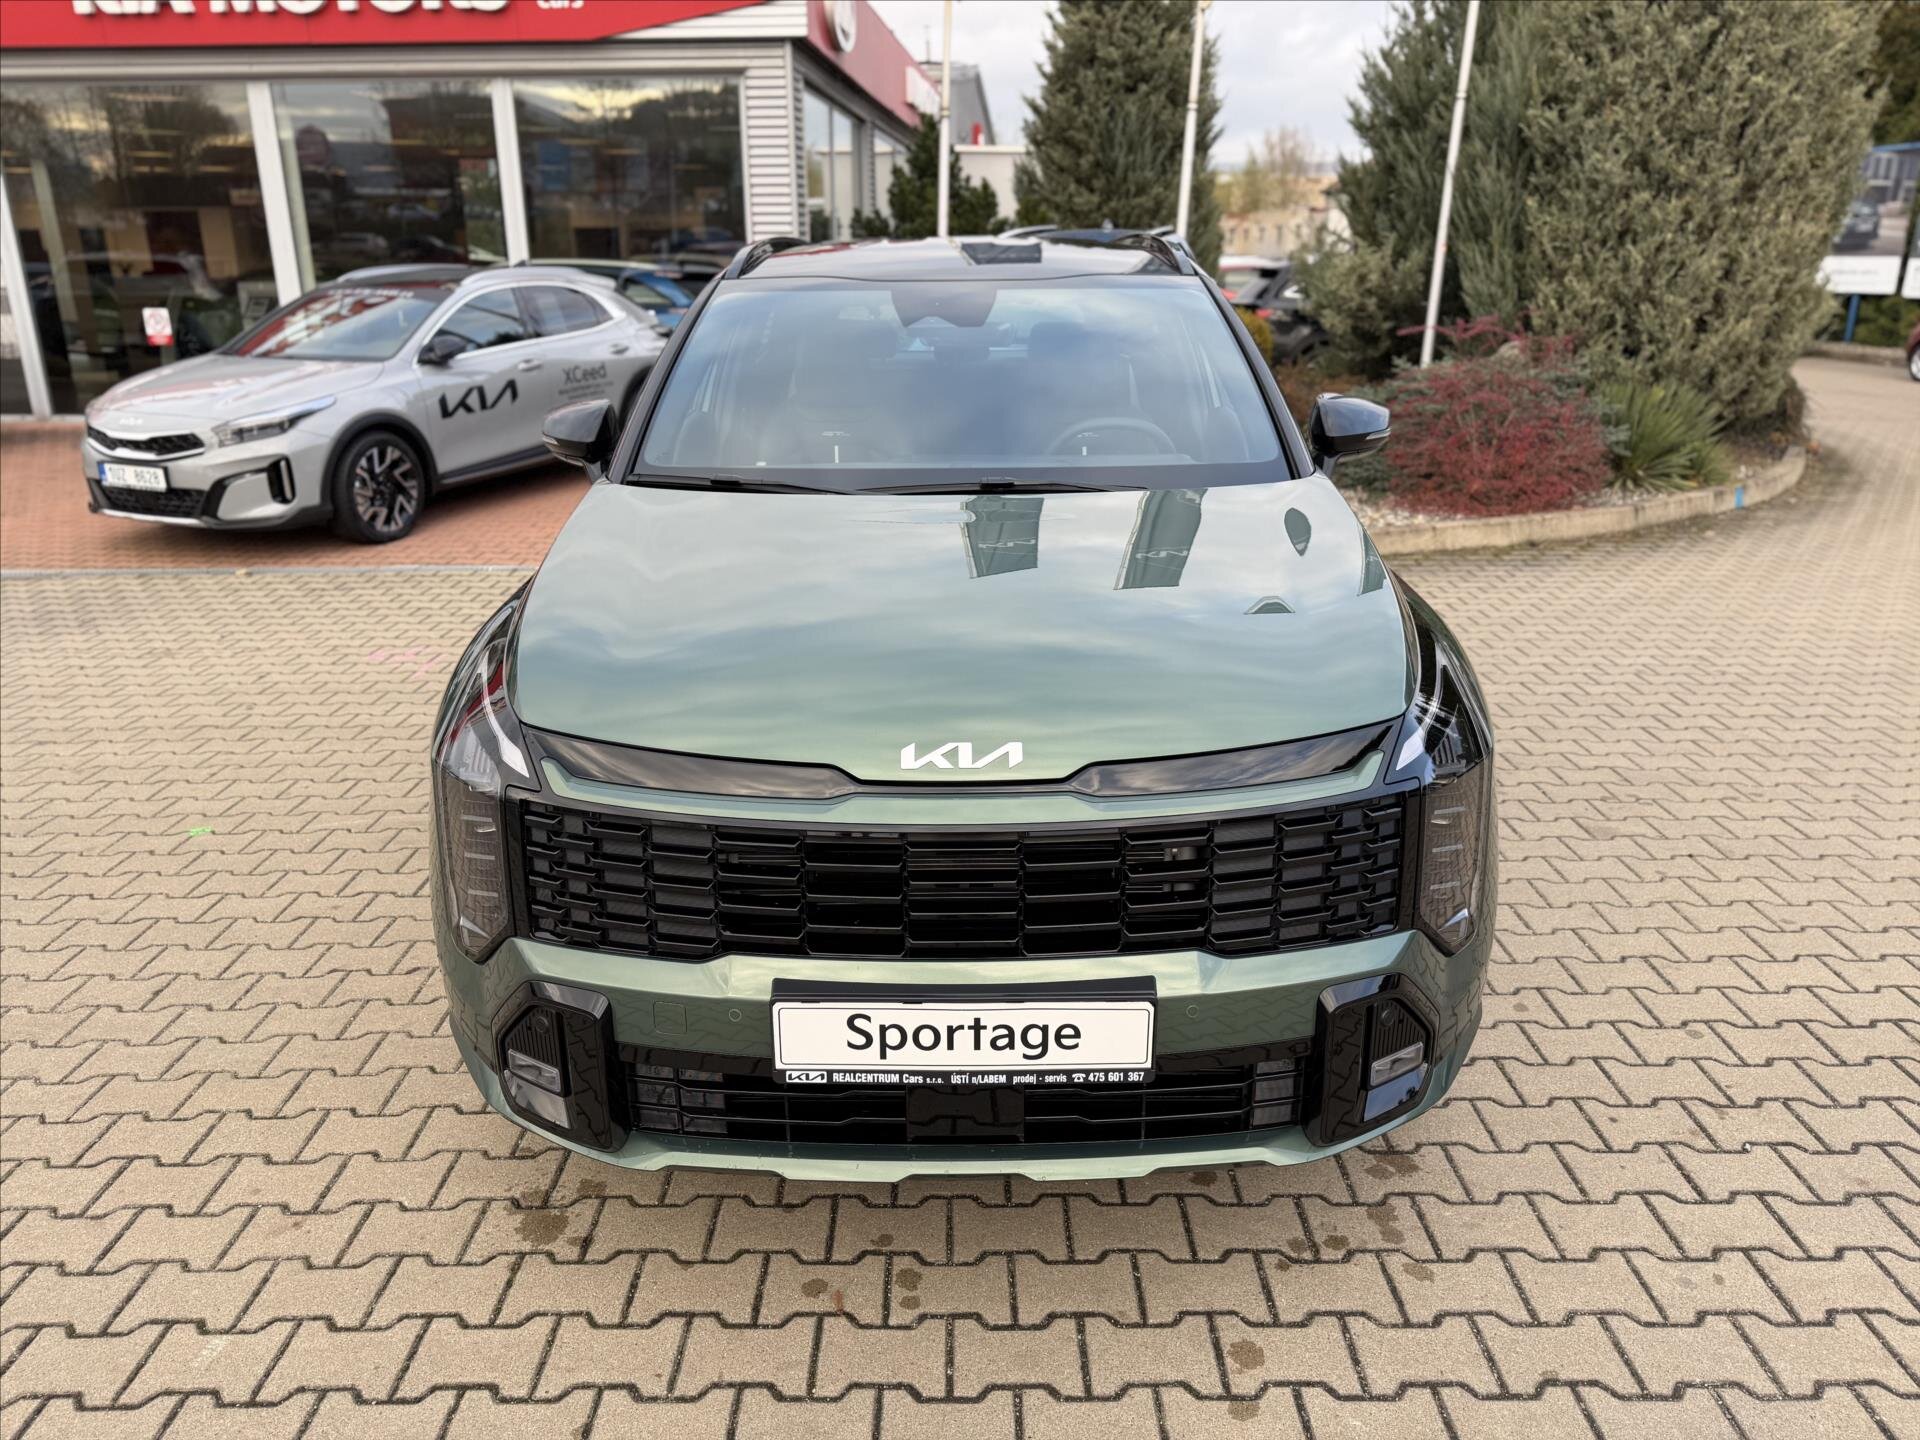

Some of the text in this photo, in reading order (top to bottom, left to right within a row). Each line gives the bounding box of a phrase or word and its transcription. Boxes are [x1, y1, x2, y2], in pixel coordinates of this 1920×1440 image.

[562, 362, 608, 385] XCeed
[437, 378, 519, 420] KIA
[900, 741, 1024, 770] KIA
[845, 1012, 1083, 1061] Sportage
[787, 1071, 827, 1083] KIA
[832, 1072, 900, 1084] REALCENTRUM
[902, 1073, 924, 1084] Cars
[925, 1076, 945, 1084] s.r.o.
[951, 1072, 970, 1084] ÚSTÍ
[971, 1073, 1007, 1085] n/LABEM
[1012, 1073, 1038, 1085] prodej
[1044, 1073, 1067, 1083] servis
[1088, 1072, 1106, 1083] 475
[1107, 1072, 1125, 1082] 601
[1127, 1071, 1145, 1082] 367
